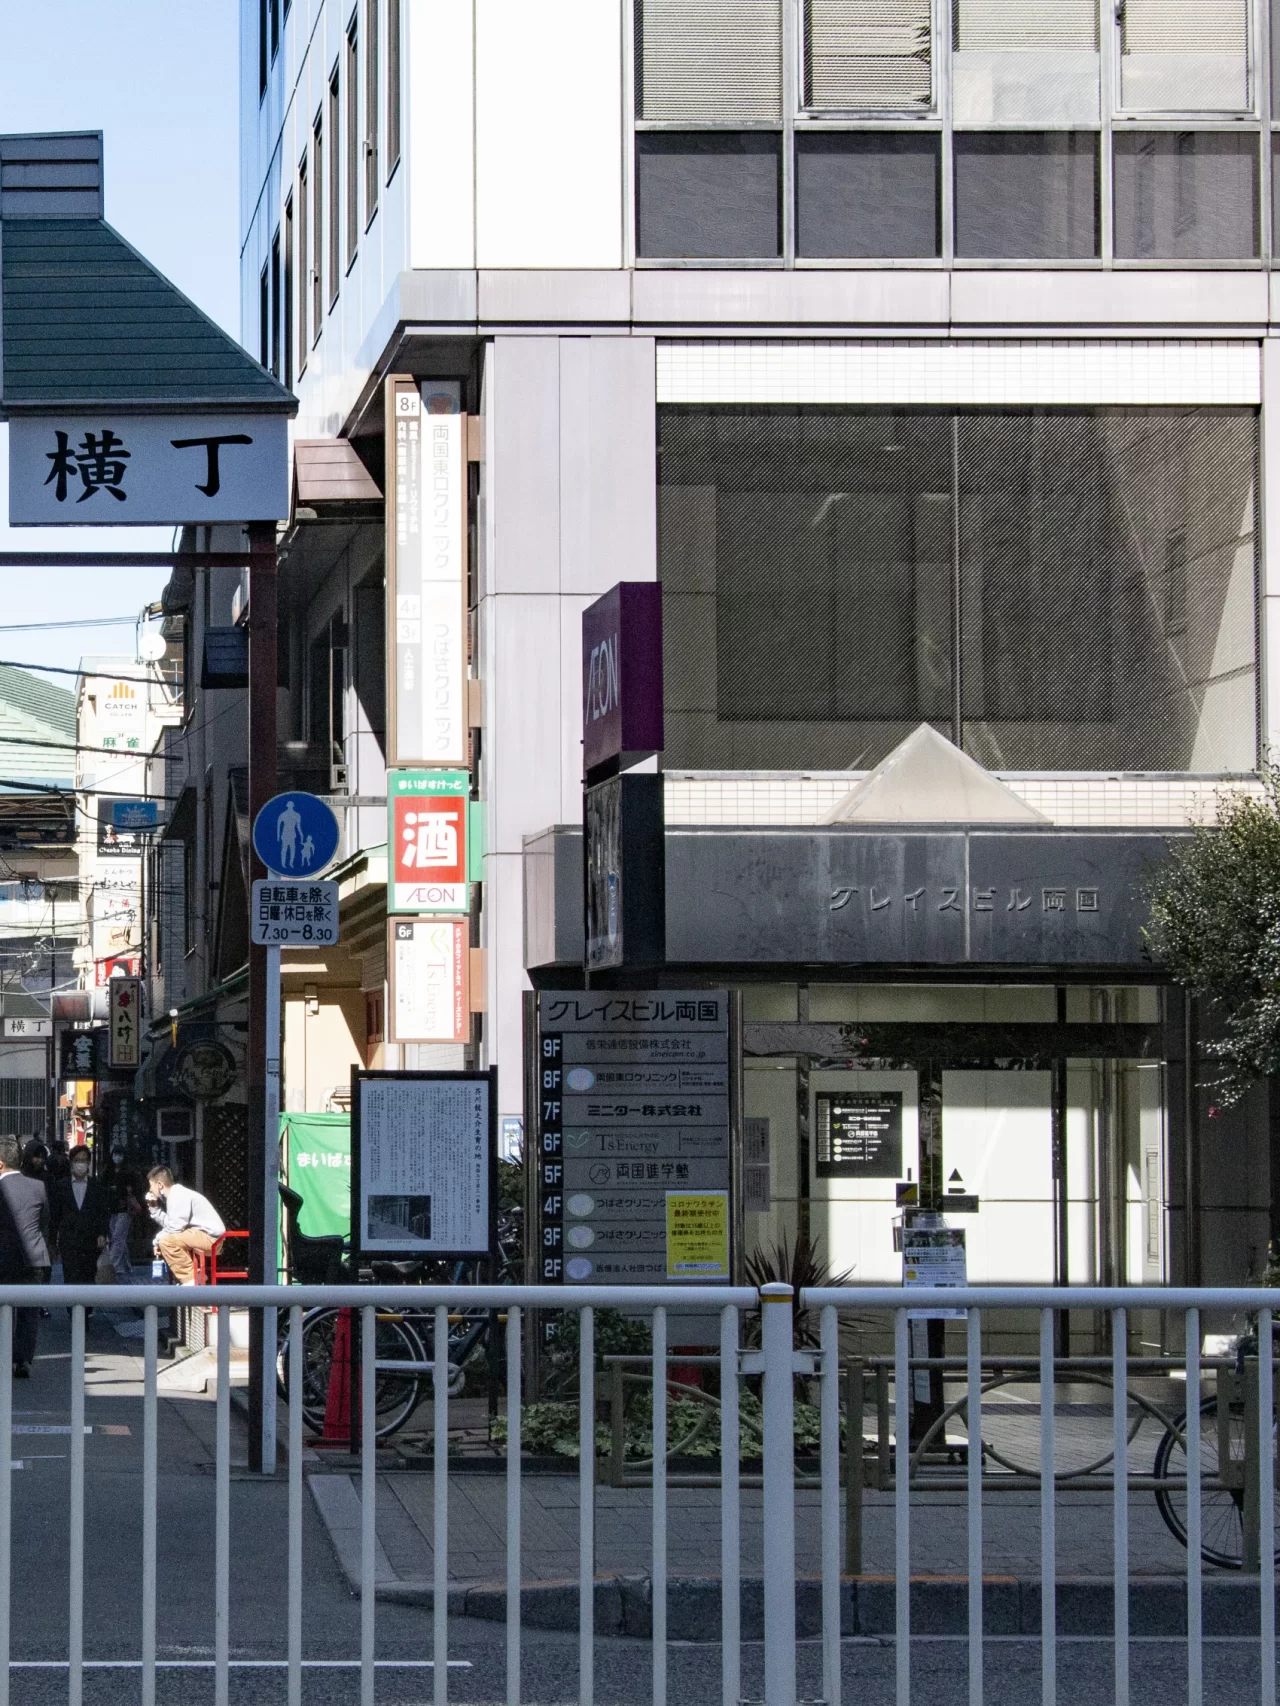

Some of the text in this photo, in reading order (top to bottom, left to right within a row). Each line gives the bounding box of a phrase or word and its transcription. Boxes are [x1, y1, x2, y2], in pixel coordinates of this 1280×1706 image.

[400, 397, 417, 411] 8F
[45, 430, 253, 504] 横丁
[433, 424, 449, 569] 両国東口クリニック
[433, 624, 451, 750] つばさクリニック
[102, 737, 140, 748] 麻雀
[398, 779, 463, 790] まいばすけっと
[401, 811, 458, 868] 酒
[260, 886, 332, 903] 自転車を除く
[830, 886, 1100, 912] グレイスビル両国
[260, 905, 332, 922] 日曜・休日を除く
[398, 926, 412, 938] 6F
[549, 1000, 719, 1022] グレイスビル両国
[11, 1020, 47, 1033] 横丁
[543, 1038, 692, 1058] 9F 信栄通信設備株式会社
[543, 1070, 561, 1089] 8F
[596, 1073, 677, 1083] 両国東口クリニック
[543, 1101, 561, 1120] 7F
[474, 1087, 483, 1160] 芥川龍之介生育の地
[543, 1133, 561, 1152] 6F
[544, 1162, 690, 1184] 5F 両国進学塾
[544, 1196, 667, 1214] 4F つばさクリニック
[544, 1227, 667, 1246] 3F つばさクリニック
[544, 1259, 562, 1277] 2F
